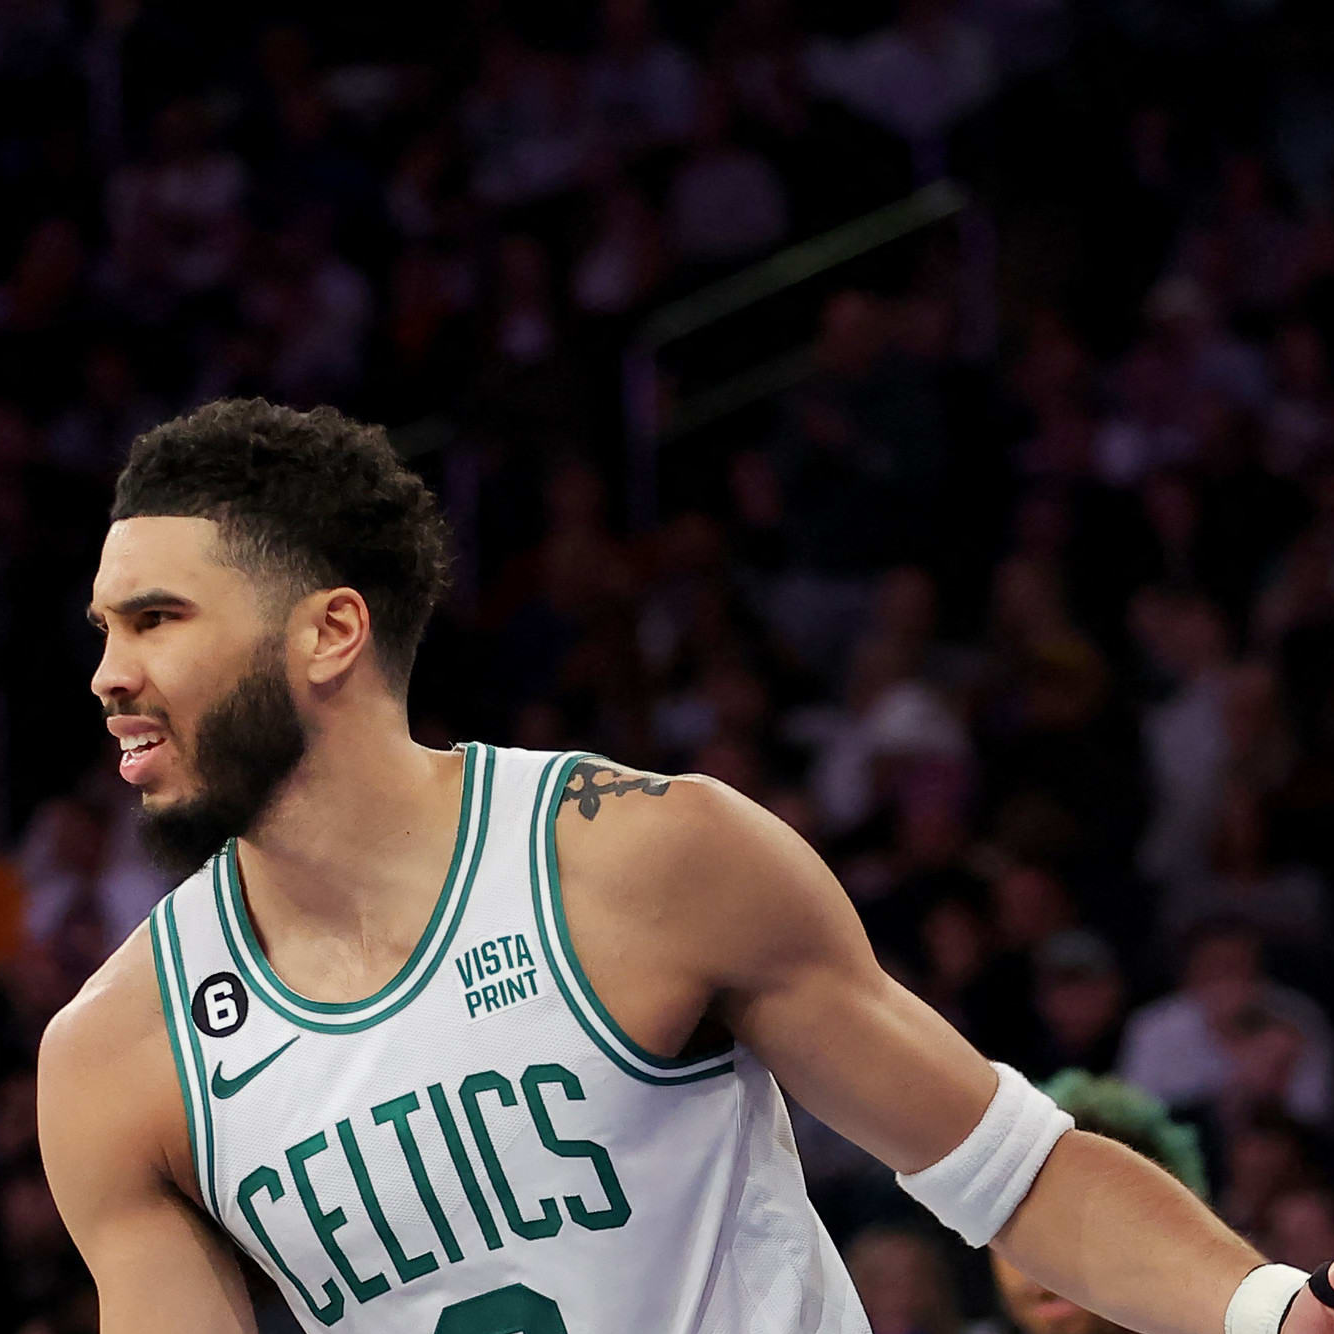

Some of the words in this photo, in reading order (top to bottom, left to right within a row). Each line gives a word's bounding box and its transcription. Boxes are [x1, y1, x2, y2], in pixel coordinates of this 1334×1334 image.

[455, 934, 534, 989] VISTA
[203, 980, 240, 1031] 6
[465, 968, 538, 1019] PRINT
[236, 1063, 632, 1327] CELTICS
